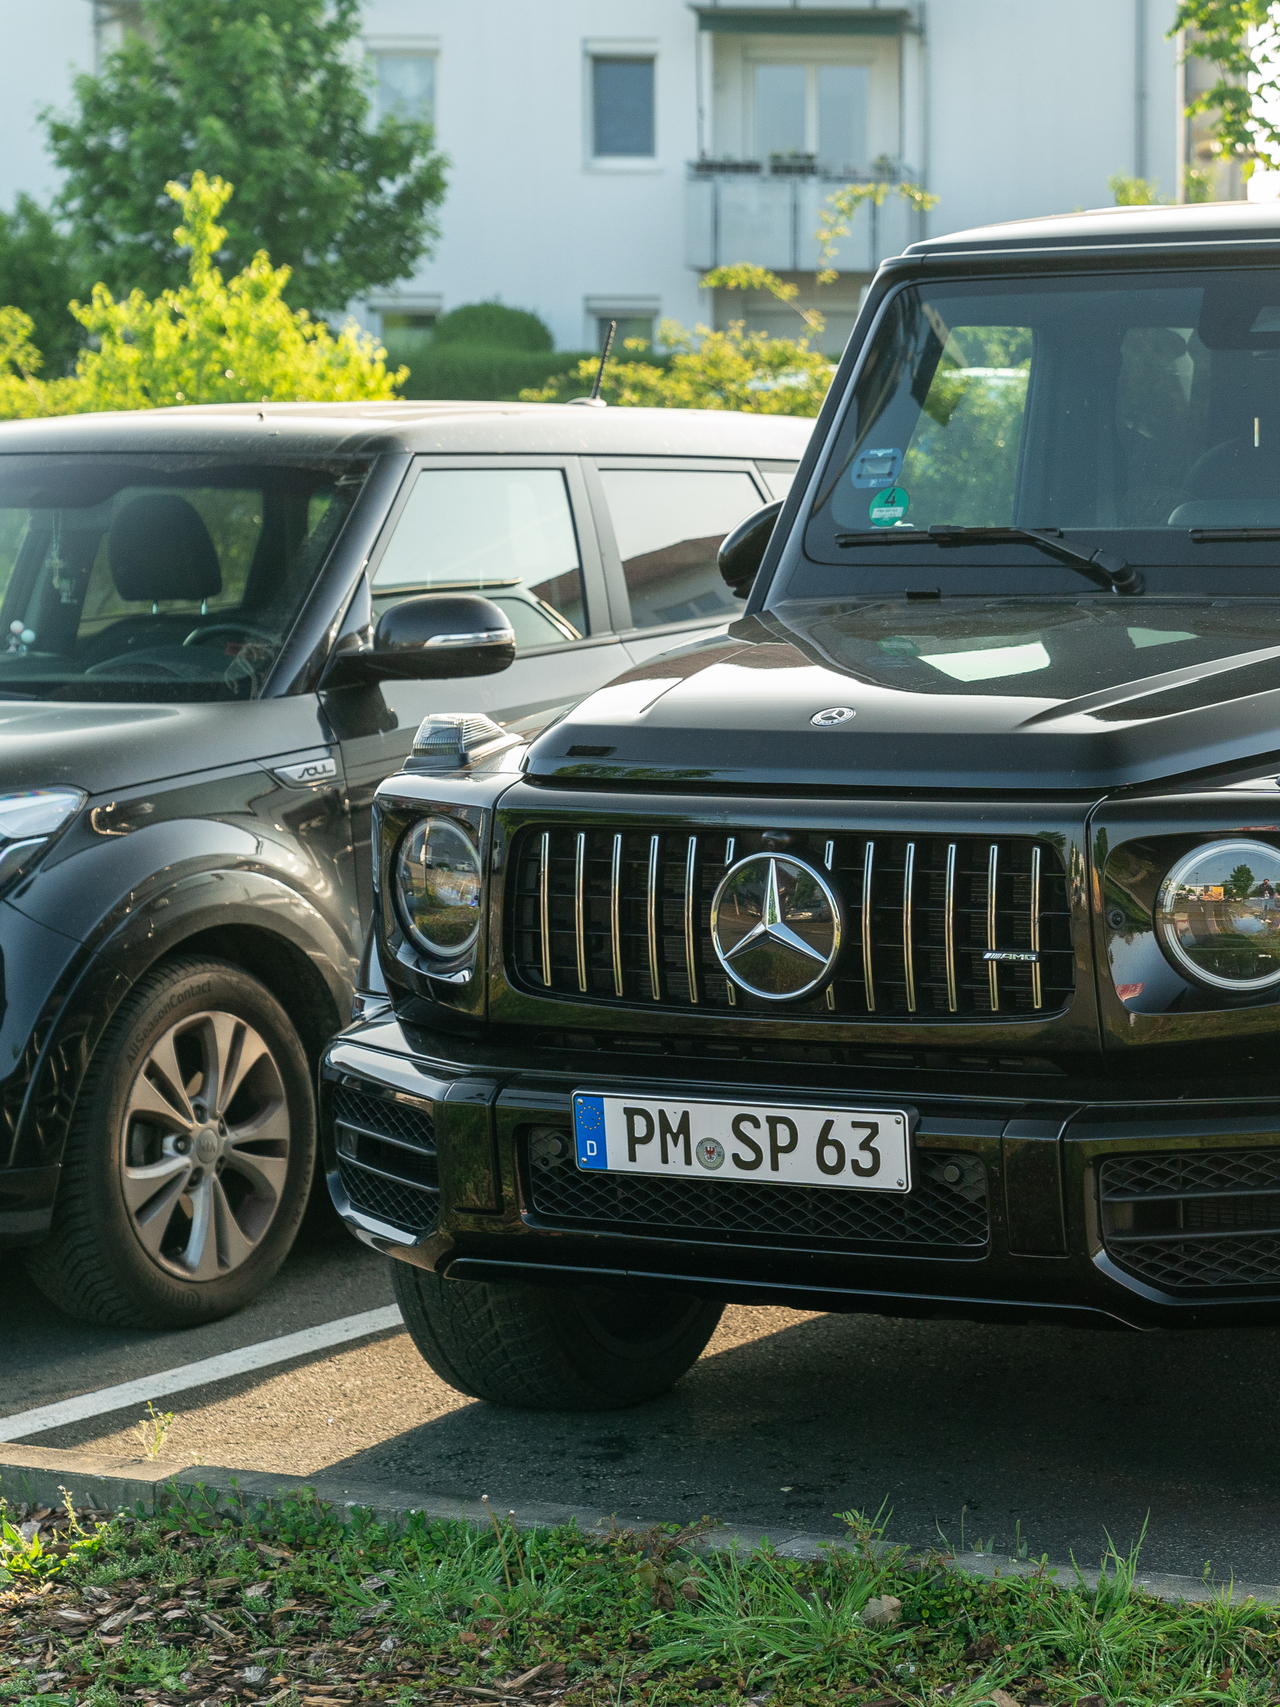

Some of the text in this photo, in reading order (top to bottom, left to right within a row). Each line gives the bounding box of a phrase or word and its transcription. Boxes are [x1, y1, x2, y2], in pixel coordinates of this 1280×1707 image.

[885, 488, 896, 506] 4
[298, 764, 334, 779] SOUL
[1000, 953, 1036, 961] AMG
[586, 1140, 597, 1156] D
[623, 1106, 692, 1166] PM
[731, 1113, 799, 1172] SP
[816, 1119, 881, 1177] 63
